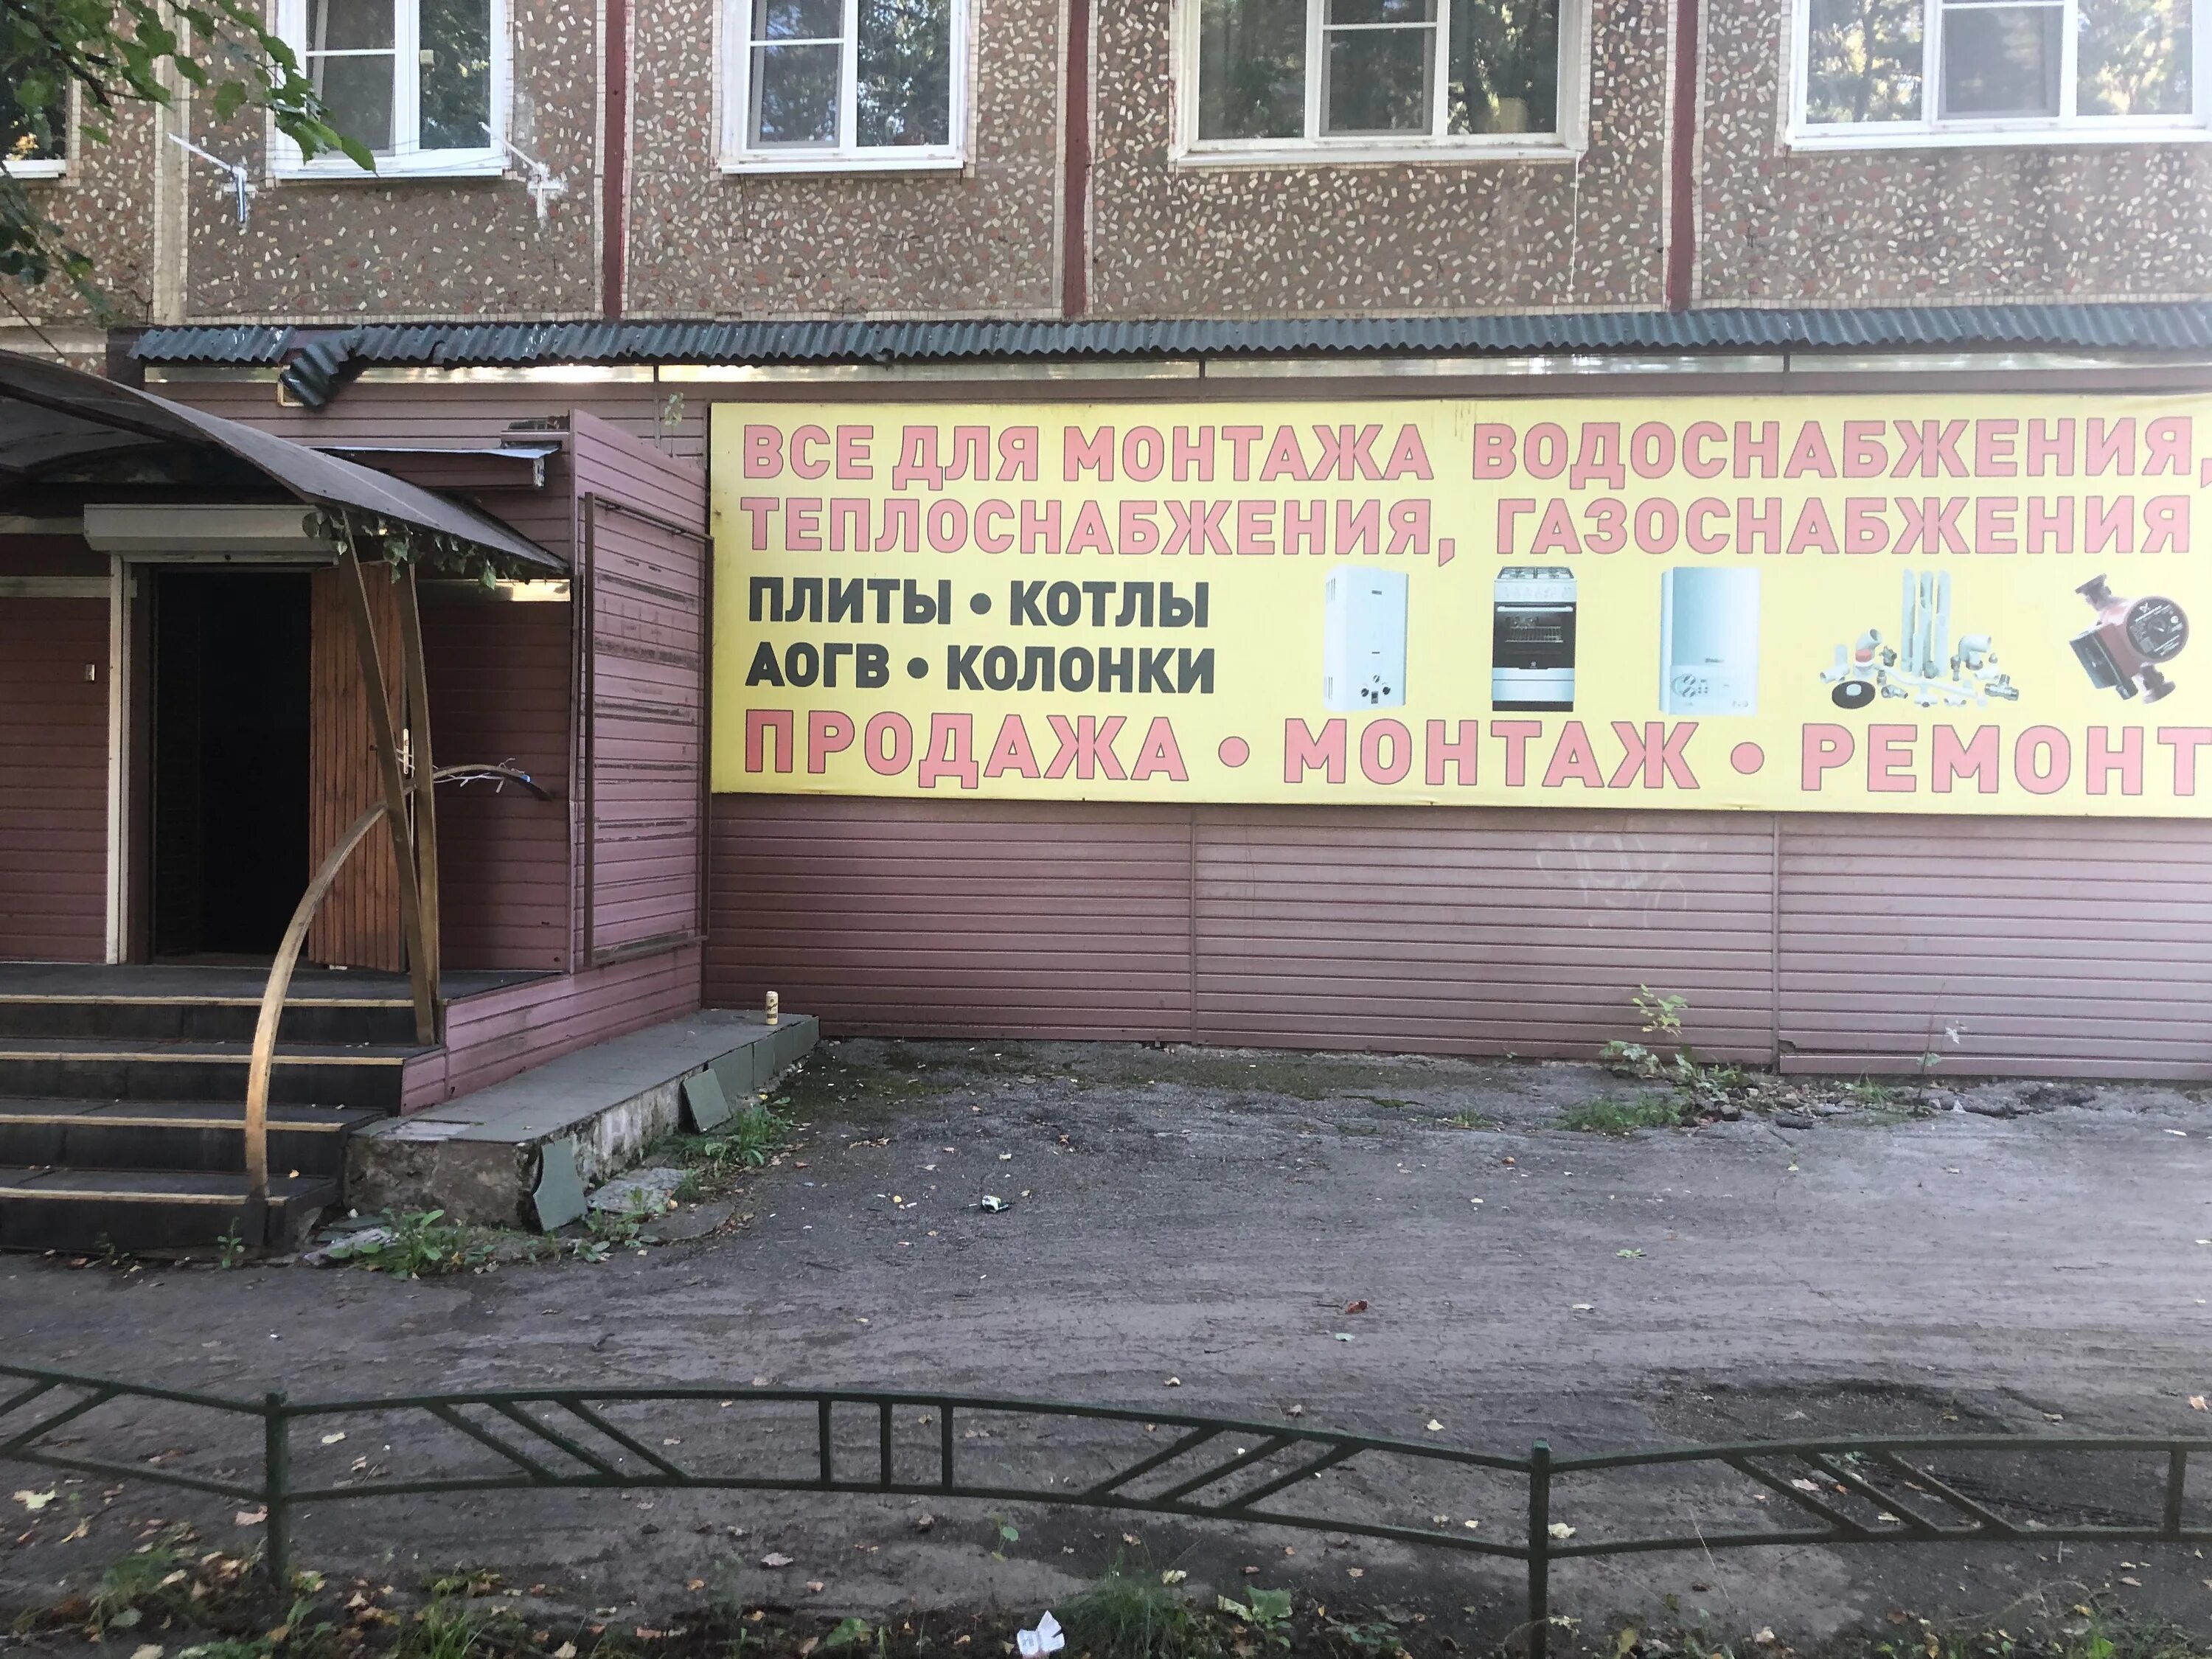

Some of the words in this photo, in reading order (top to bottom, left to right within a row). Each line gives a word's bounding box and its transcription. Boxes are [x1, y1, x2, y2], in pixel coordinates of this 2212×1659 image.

[743, 425, 874, 480] ВСЕ
[892, 425, 1039, 490] ДЛЯ
[1063, 425, 1435, 481] МОНТАЖА
[740, 496, 1456, 567] ТЕПЛОСНАБЖЕНИЯ,
[1496, 495, 2190, 554] ГАЗОСНАБЖЕНИЯ
[748, 577, 951, 626] ПЛИТЫ
[1009, 580, 1211, 628] КОТЛЫ
[745, 641, 890, 689] АОГВ
[946, 645, 1216, 695] КОЛОНКИ
[744, 709, 1189, 790] ПРОДАЖА
[1283, 717, 1700, 790] МОНТАЖ
[1801, 722, 2212, 796] РЕМОНТ
